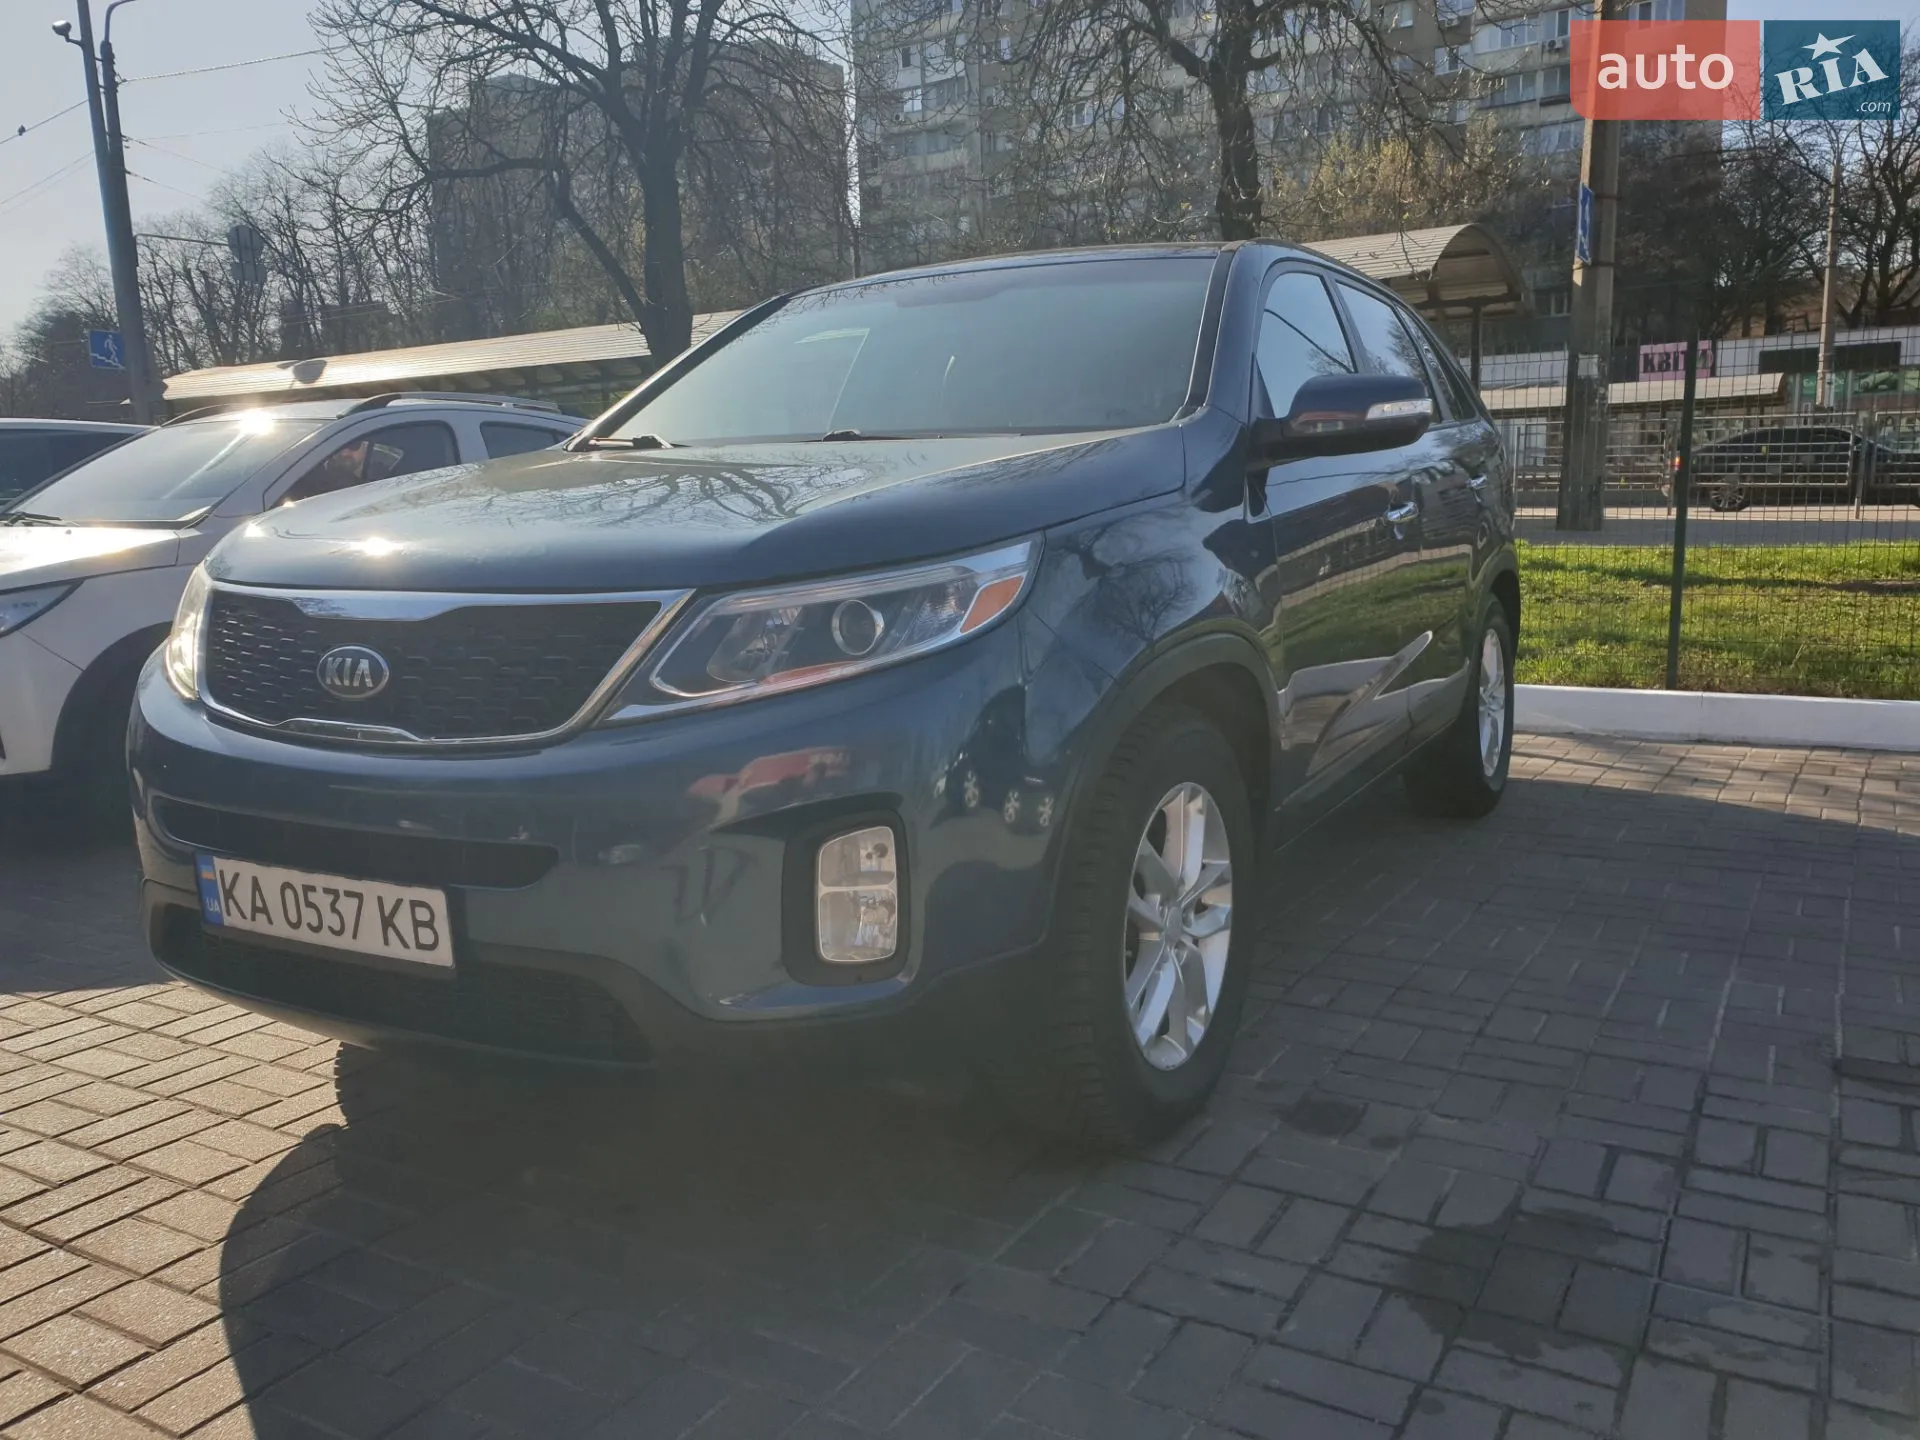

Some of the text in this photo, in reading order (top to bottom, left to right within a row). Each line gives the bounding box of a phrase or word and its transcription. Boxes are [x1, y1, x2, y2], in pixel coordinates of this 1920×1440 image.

[325, 657, 374, 688] KIA
[205, 897, 221, 914] UA
[219, 868, 440, 951] KA 0537 KB
